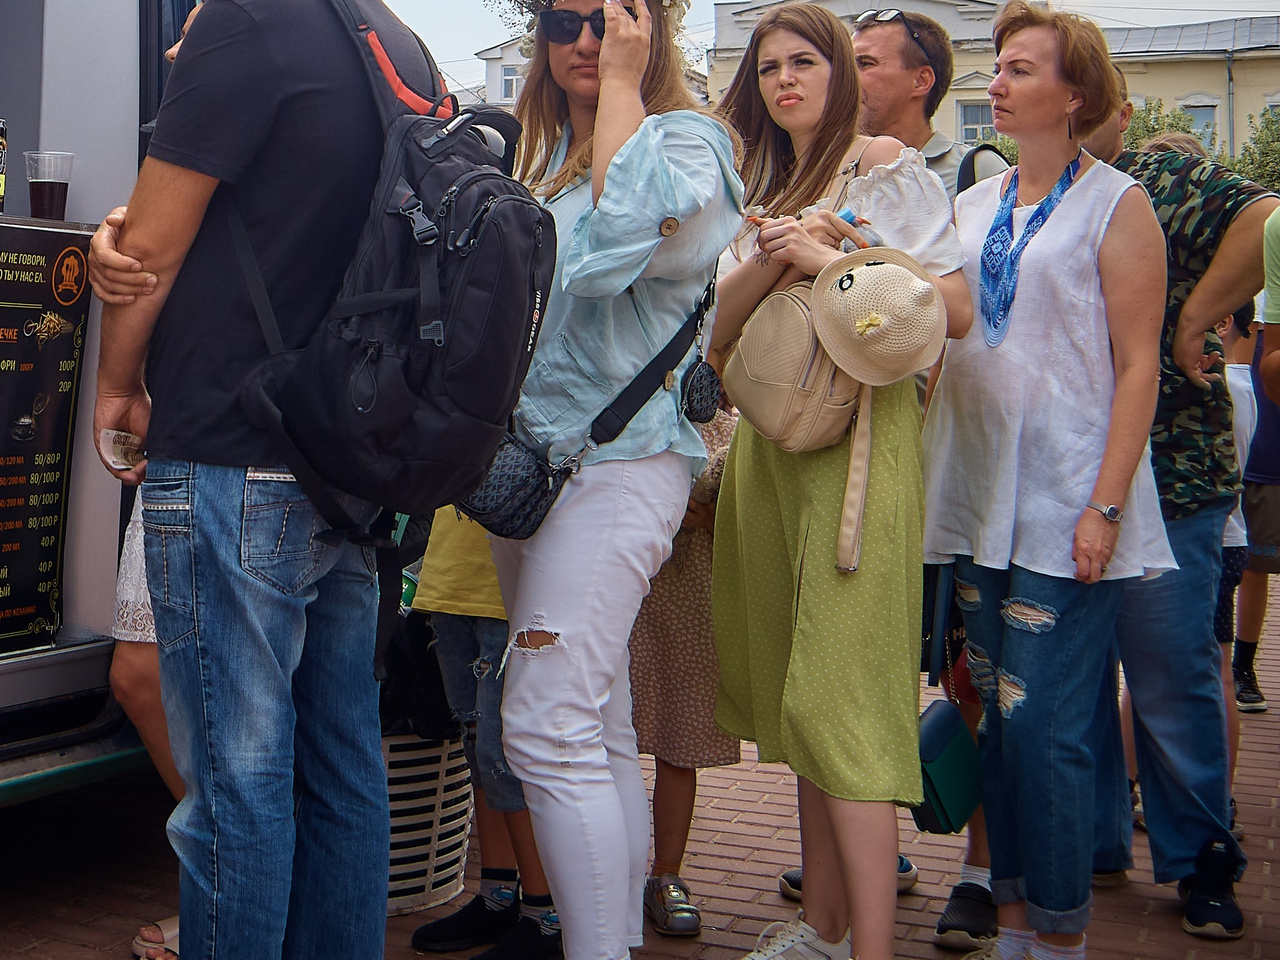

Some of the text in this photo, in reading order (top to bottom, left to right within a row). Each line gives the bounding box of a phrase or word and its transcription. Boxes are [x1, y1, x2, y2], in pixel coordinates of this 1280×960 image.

[8, 252, 18, 265] НЕ
[19, 254, 47, 267] ГОВОРИ,
[4, 269, 14, 281] ТЫ
[14, 270, 20, 282] У
[20, 271, 35, 283] НАС
[0, 359, 16, 371] ФРИ
[34, 453, 56, 467] 50/80
[29, 472, 55, 486] 80/100
[28, 493, 54, 507] 80/100
[27, 516, 53, 530] 80/100
[1, 543, 13, 552] 200
[40, 536, 50, 547] 40
[38, 561, 47, 573] 40
[37, 582, 46, 593] 40
